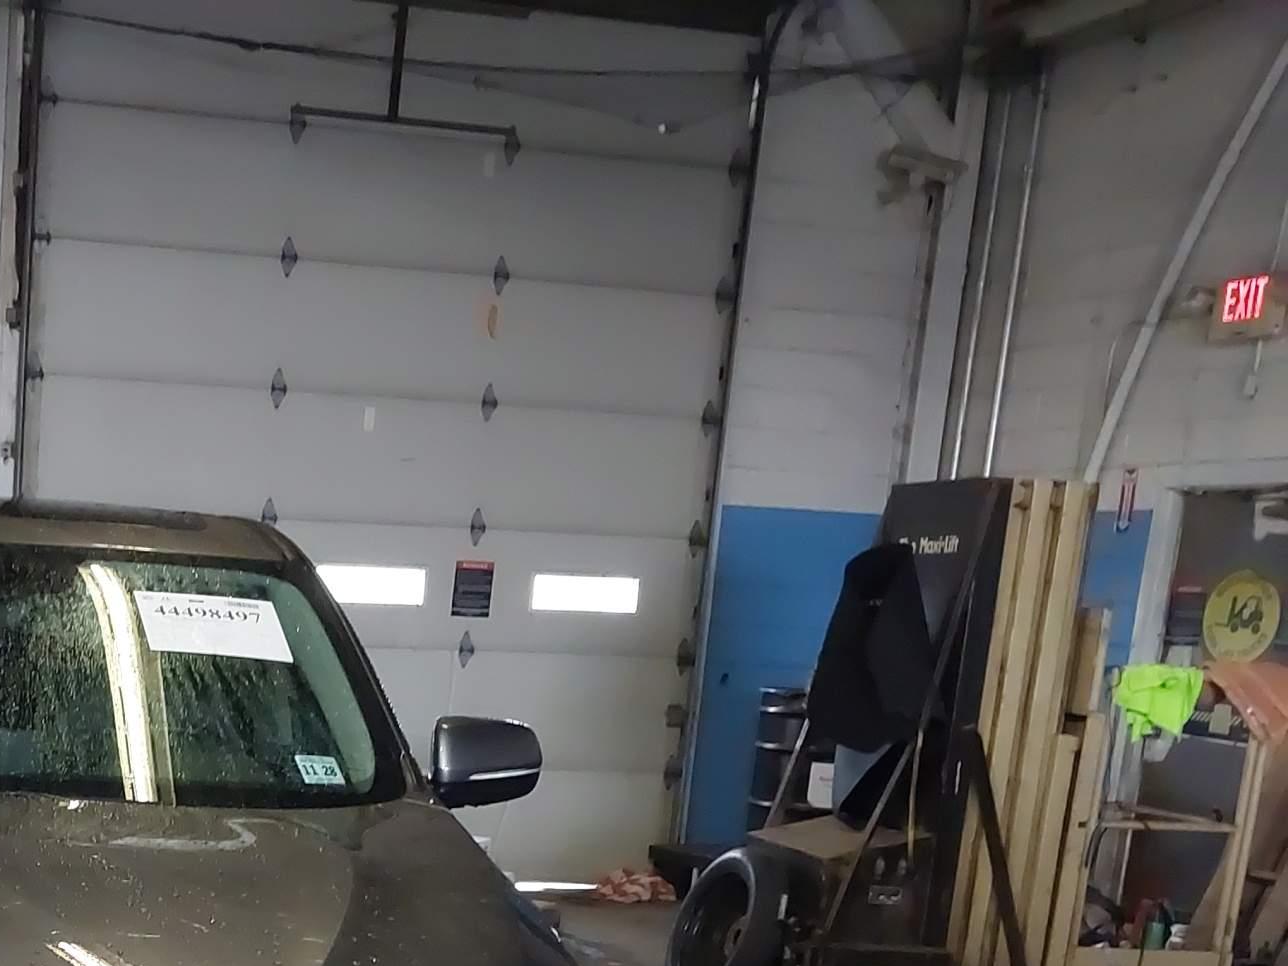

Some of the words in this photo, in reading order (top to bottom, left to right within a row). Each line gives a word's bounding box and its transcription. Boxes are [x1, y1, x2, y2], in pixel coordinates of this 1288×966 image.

[1223, 275, 1269, 323] EXIT
[154, 605, 261, 624] 44498497
[302, 764, 318, 776] 11
